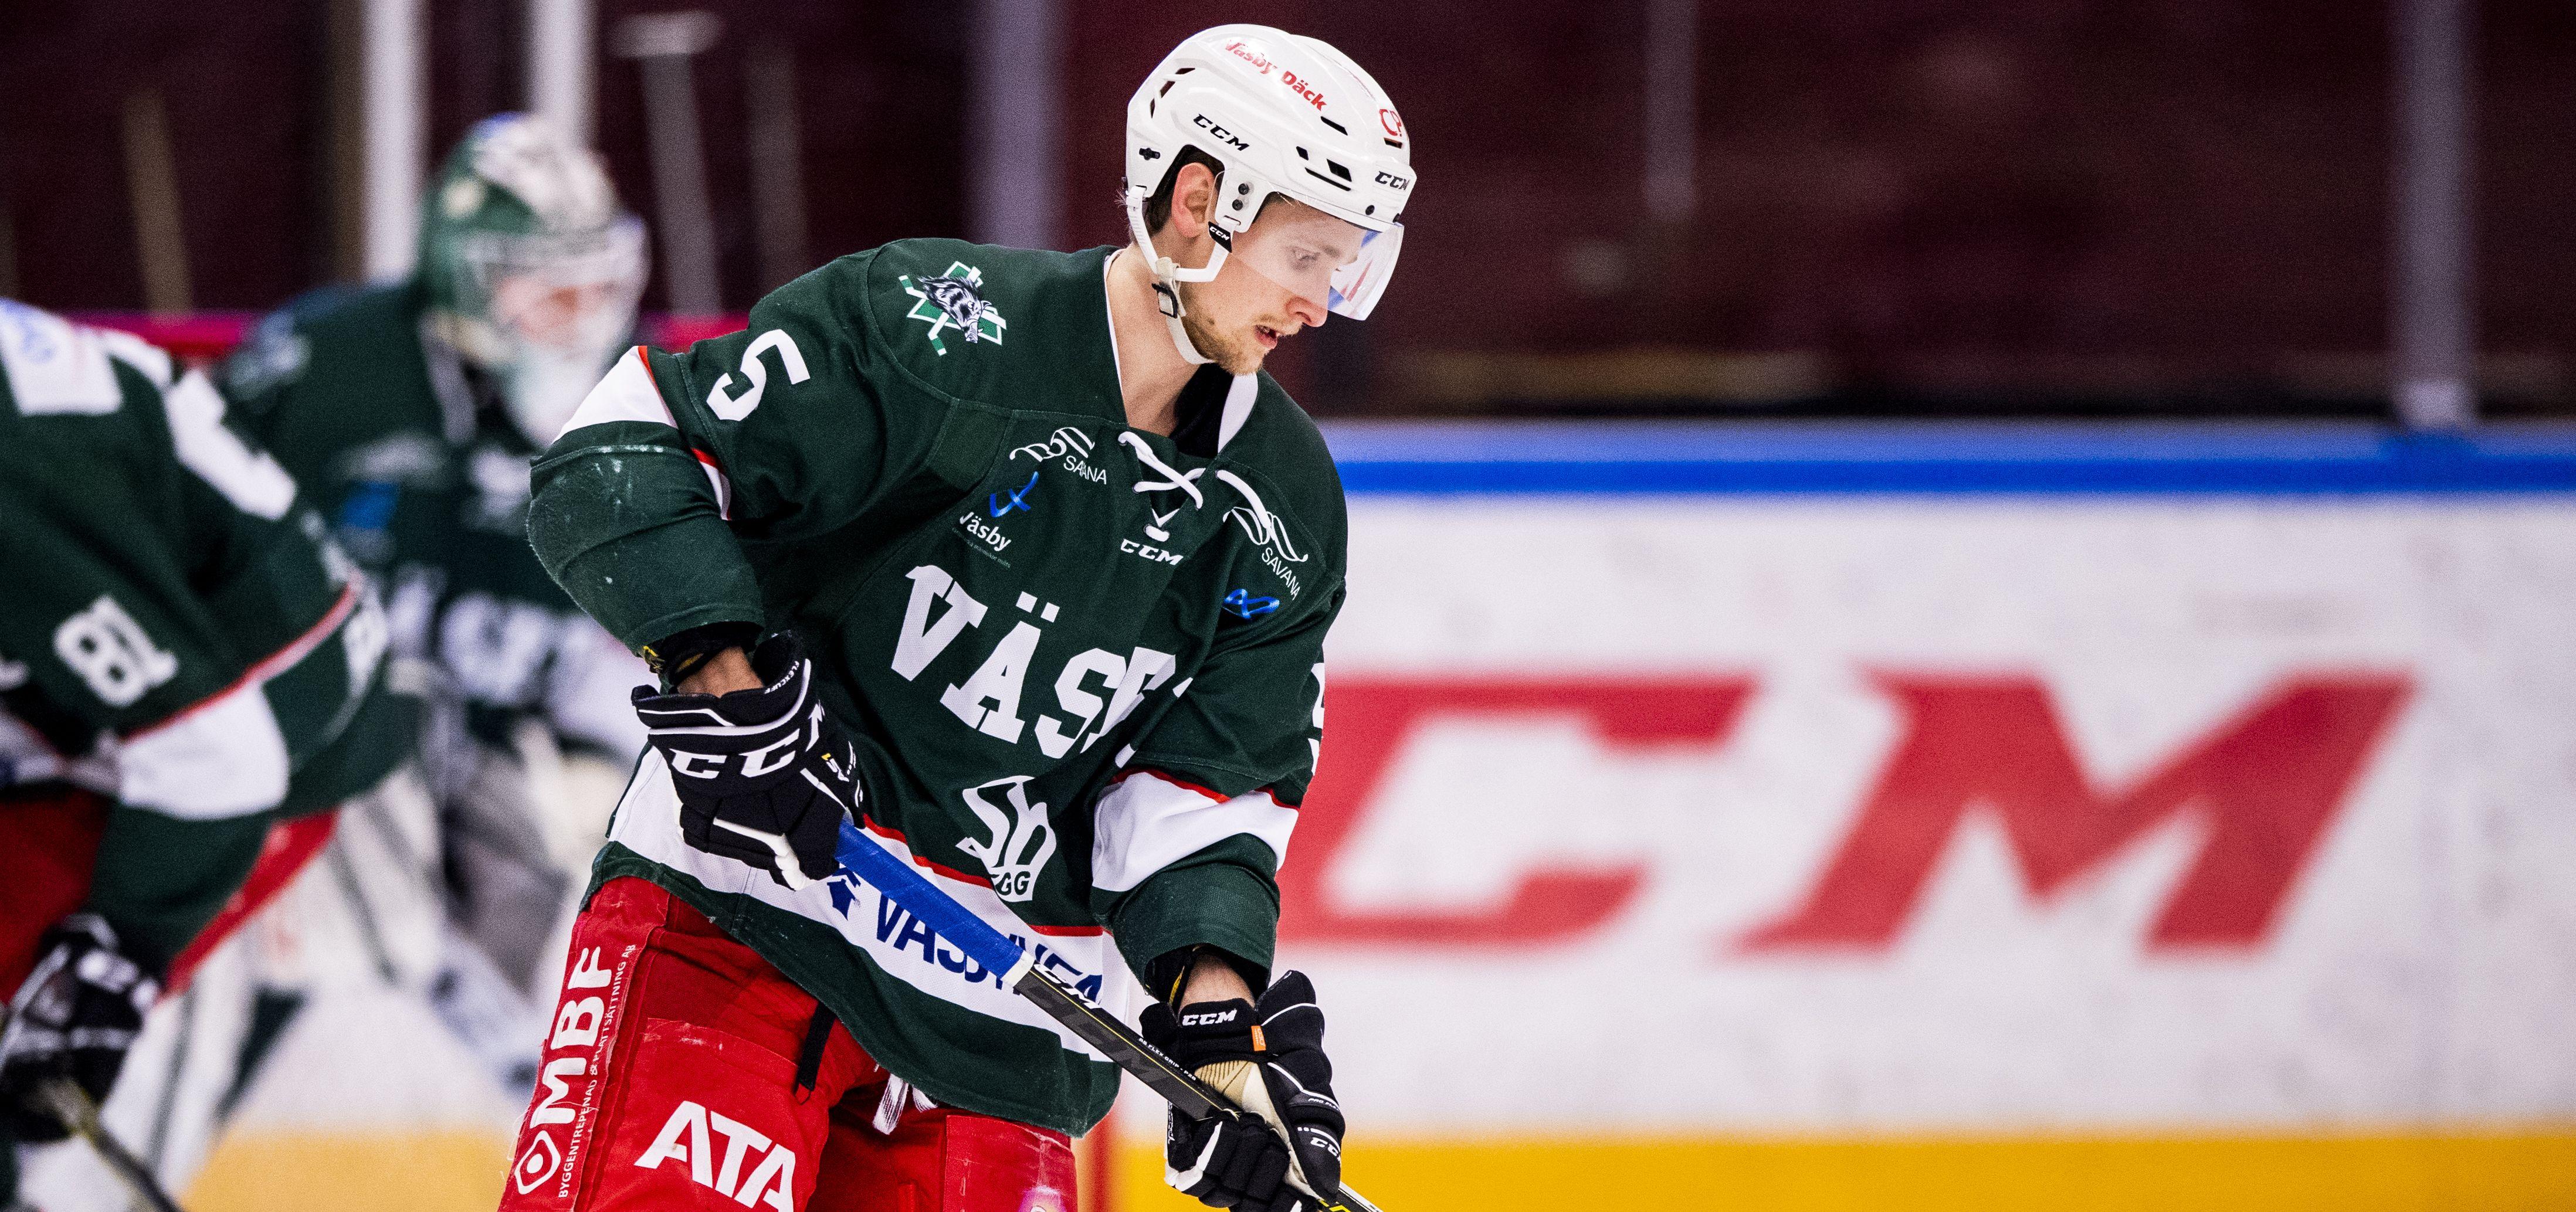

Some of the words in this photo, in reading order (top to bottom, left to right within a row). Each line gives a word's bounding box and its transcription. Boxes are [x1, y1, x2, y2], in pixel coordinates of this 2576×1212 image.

[1281, 70, 1327, 111] Däck
[1193, 114, 1250, 151] CCM
[1209, 226, 1230, 240] CCM
[706, 329, 811, 422] 5
[1063, 455, 1107, 485] SAANA
[1120, 538, 1184, 565] CCM
[1262, 547, 1300, 601] SAVANA
[54, 596, 178, 706] 81
[764, 660, 800, 694] FLEXCUFF
[1277, 671, 2415, 957] CM
[1033, 963, 1103, 1009] CM
[530, 946, 612, 1129] MBF
[1182, 1009, 1238, 1026] CCM
[558, 1079, 598, 1199] BYGGENTREPENAD
[622, 944, 636, 958] AB
[1148, 1044, 1164, 1057] FLEX
[1164, 1056, 1180, 1068] GRIP
[633, 1100, 796, 1212] ATA
[1310, 1137, 1341, 1162] CC
